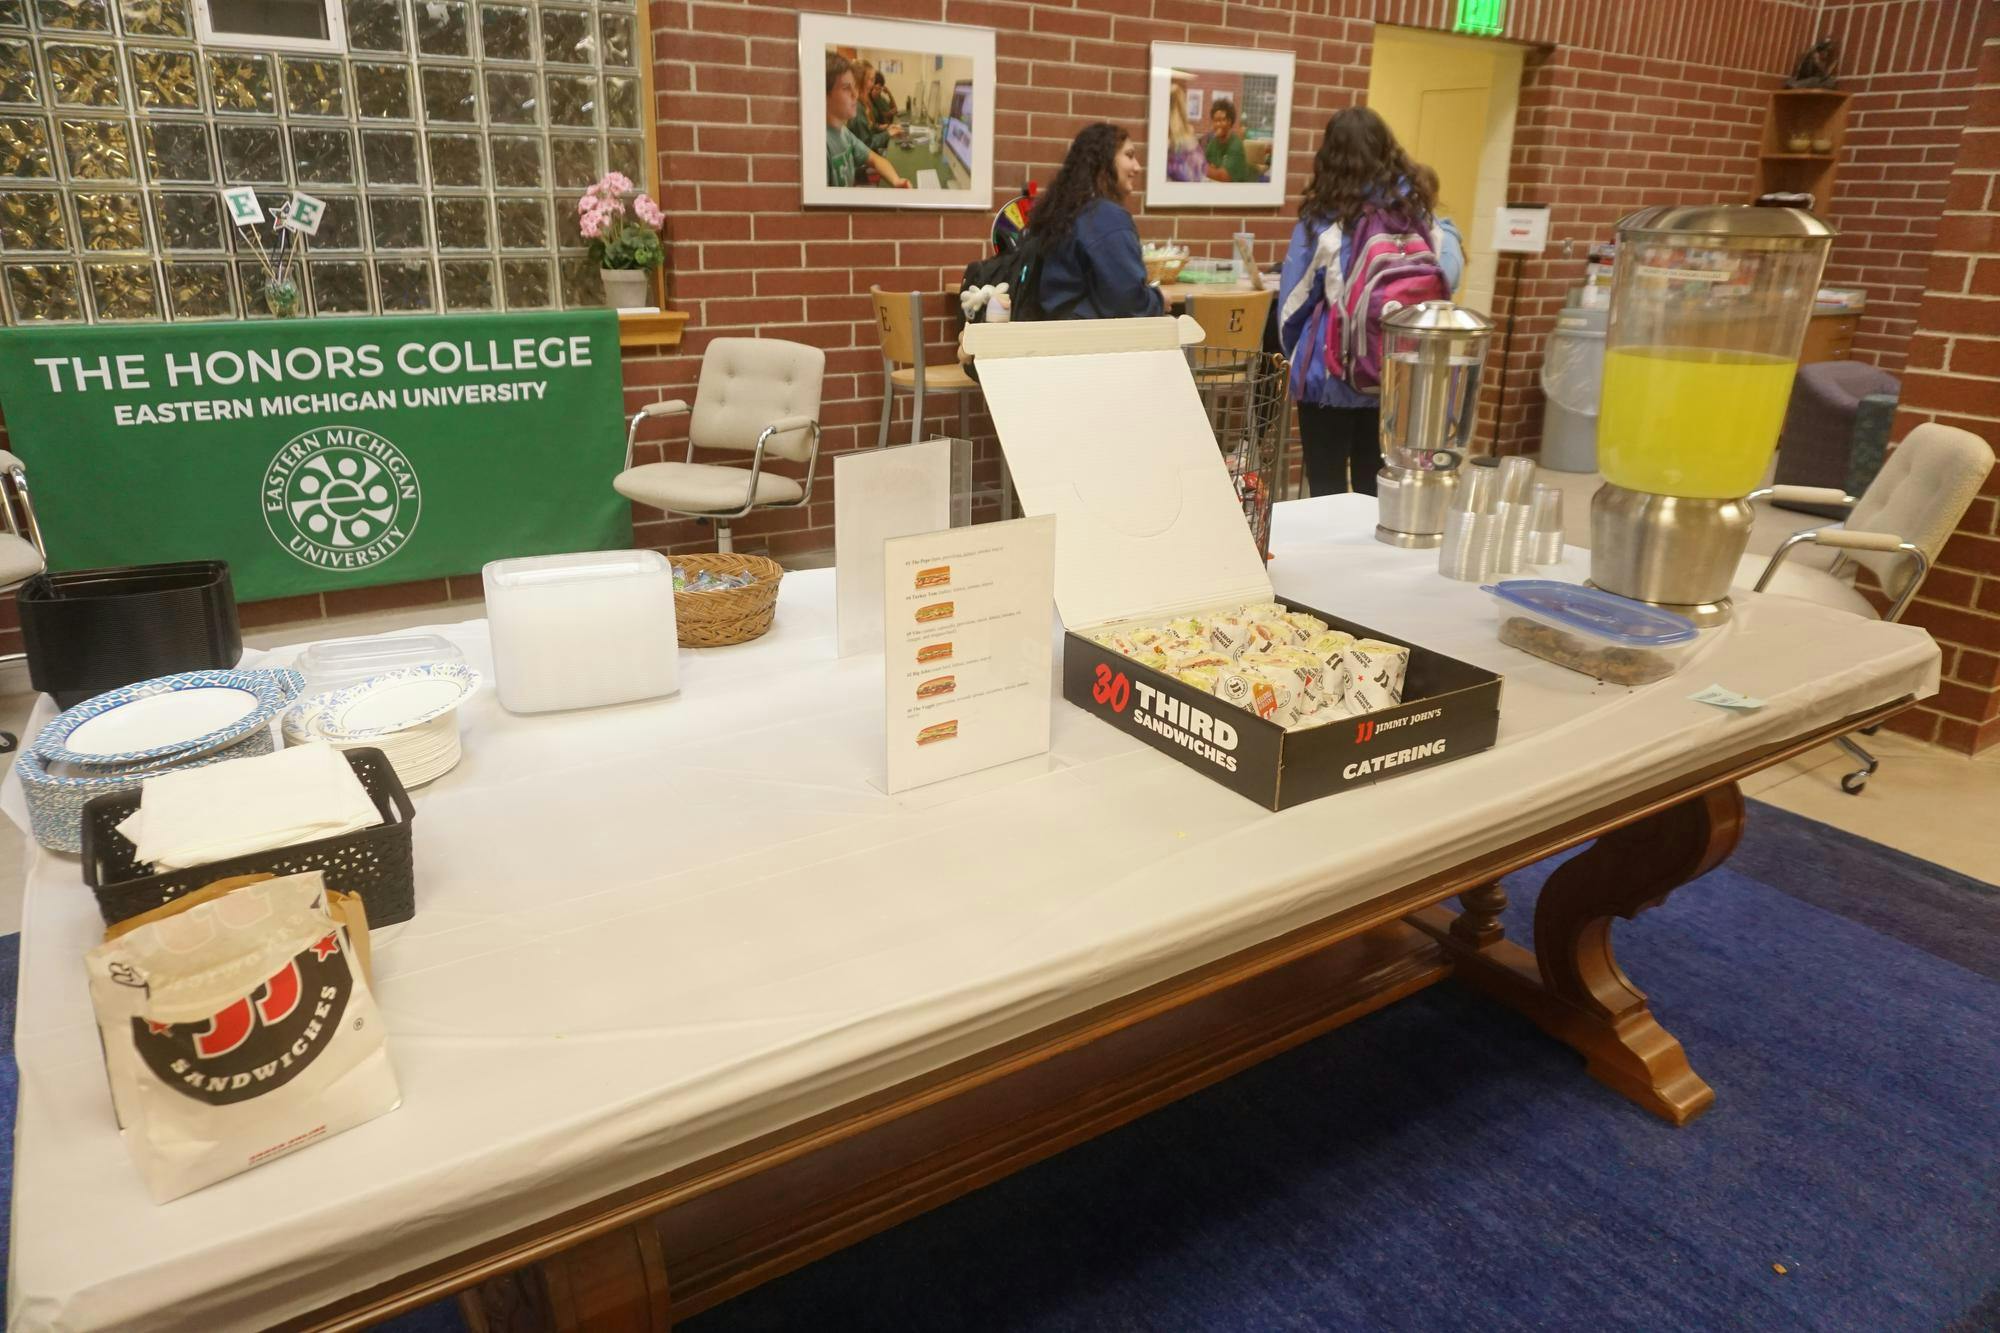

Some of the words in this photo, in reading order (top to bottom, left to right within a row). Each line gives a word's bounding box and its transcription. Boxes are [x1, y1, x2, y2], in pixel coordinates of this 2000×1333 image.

[229, 192, 256, 217] E
[293, 198, 319, 226] E
[880, 306, 891, 332] E
[1228, 308, 1245, 333] E
[34, 354, 150, 392] THE
[164, 343, 384, 387] HONORS
[396, 336, 593, 376] COLLEGE
[113, 397, 254, 426] EASTERN
[259, 389, 397, 417] MICHIGAN
[402, 381, 547, 407] UNIVERSITY
[266, 433, 321, 512] EASTERN
[326, 429, 417, 500] MICHIGAN
[289, 525, 406, 568] UNIVERSITY
[1093, 663, 1130, 713] 30
[1135, 680, 1239, 751] THIRD
[1375, 716, 1409, 735] JIMMY
[1409, 708, 1442, 726] JOHN'S
[1133, 709, 1237, 772] SANDWICHES
[1342, 739, 1447, 780] CATERING
[169, 985, 337, 1092] SANDWICHES
